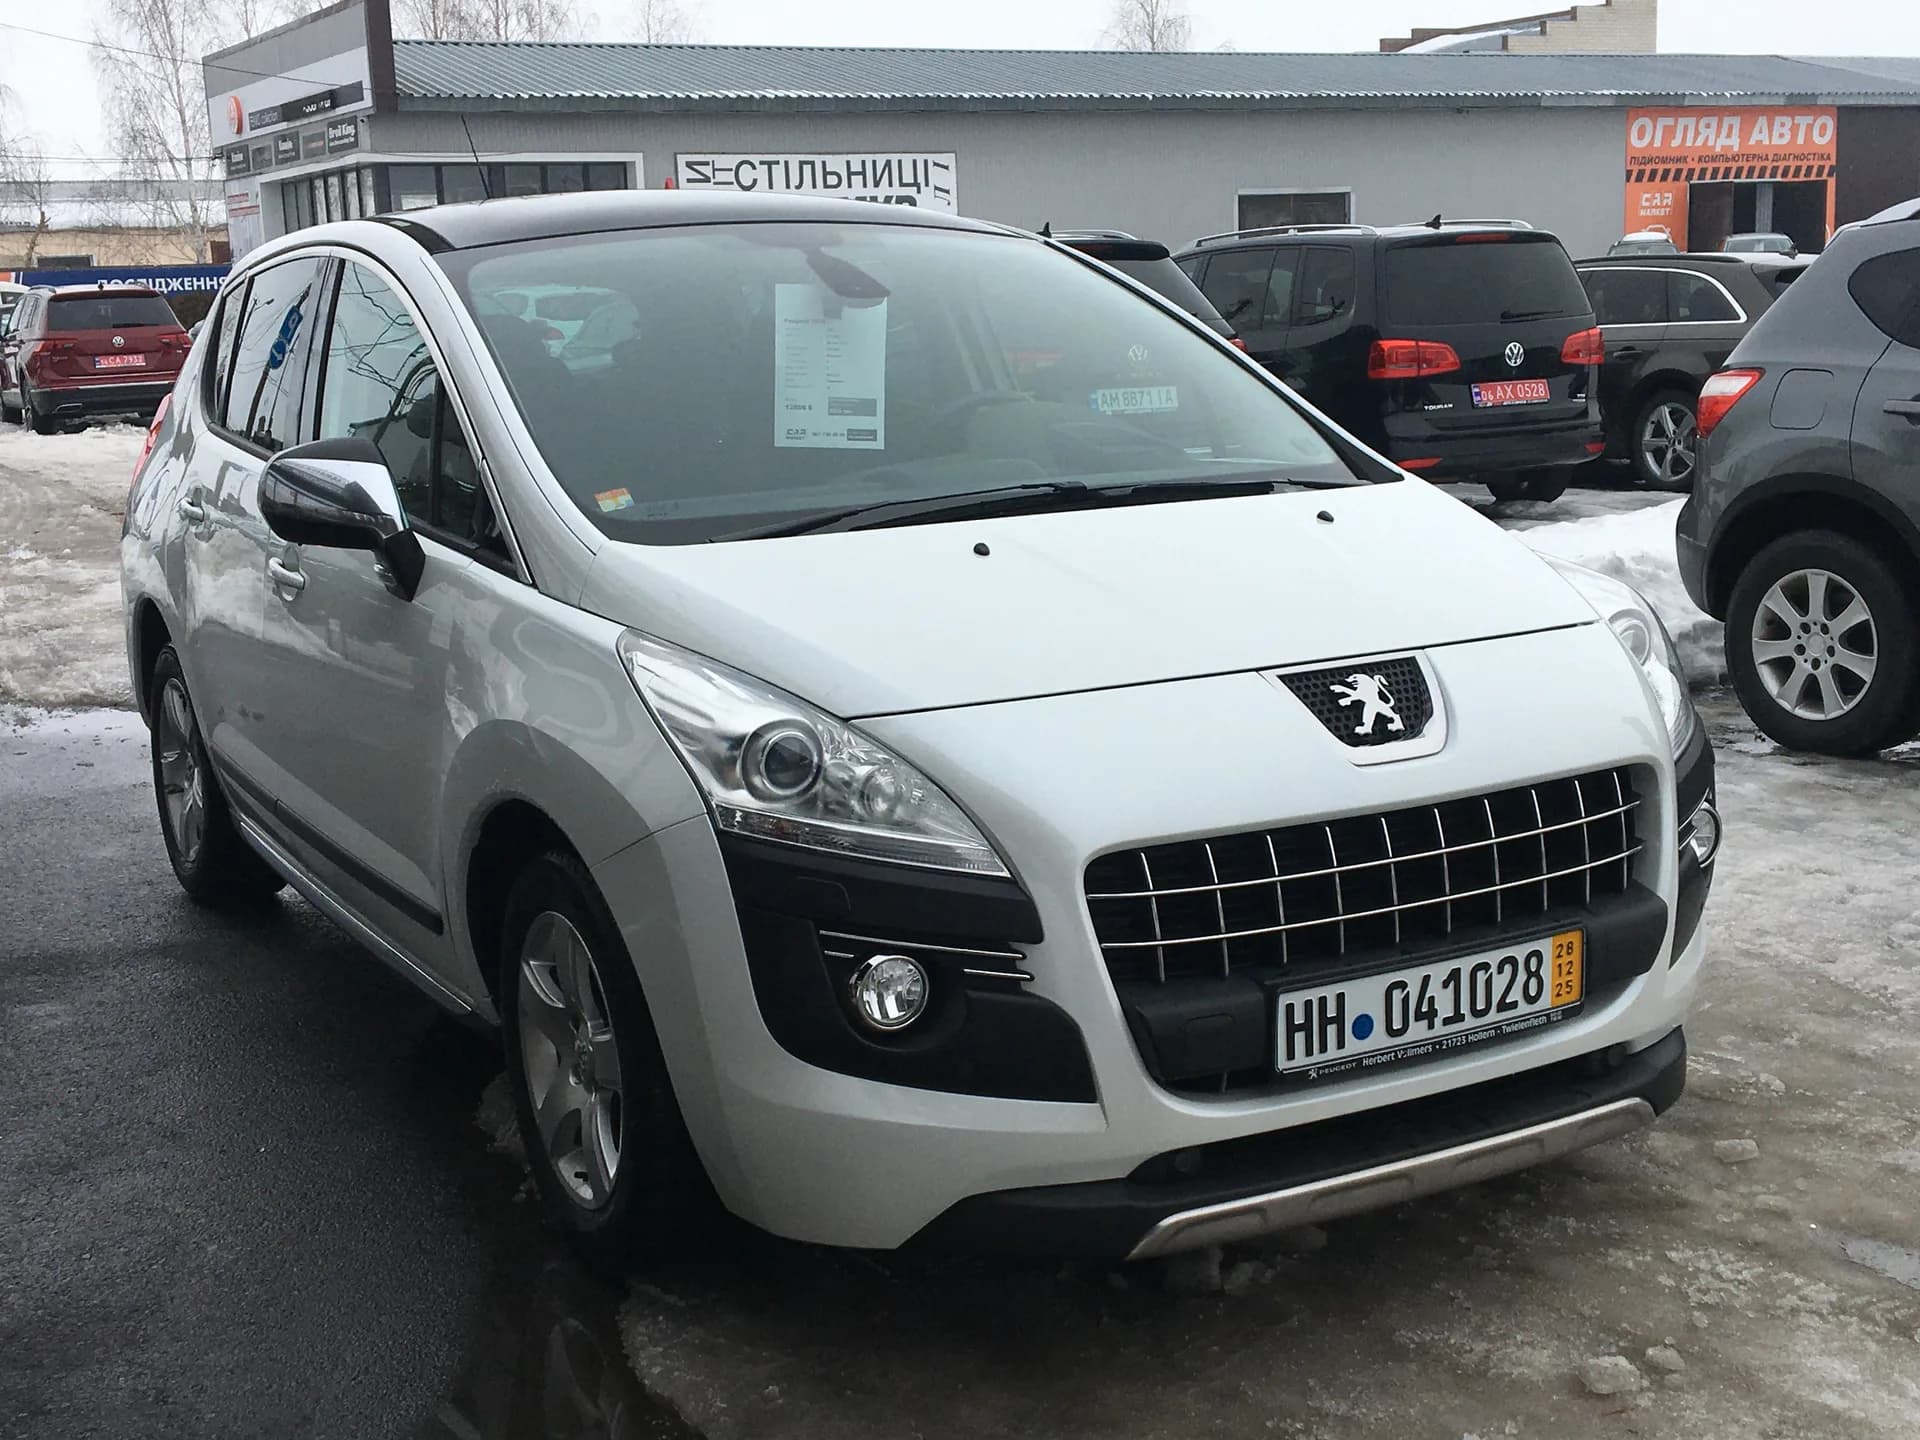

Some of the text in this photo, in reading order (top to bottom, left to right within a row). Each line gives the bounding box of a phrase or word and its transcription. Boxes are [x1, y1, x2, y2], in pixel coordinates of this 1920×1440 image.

[1630, 115, 1834, 152] ОГЛЯД АВТО
[734, 158, 930, 194] СТІЛЬНИЦІ
[1642, 192, 1673, 206] CAR
[1101, 391, 1120, 408] AM
[1481, 383, 1545, 401] 06 AX 0528
[1555, 940, 1575, 957] 28
[1556, 960, 1574, 977] 12
[1554, 981, 1574, 997] 25
[1285, 949, 1544, 1061] HH 041028
[1320, 1062, 1357, 1075] PEUGEOT
[1362, 1050, 1395, 1067] Herbert
[1442, 1035, 1467, 1049] 21723
